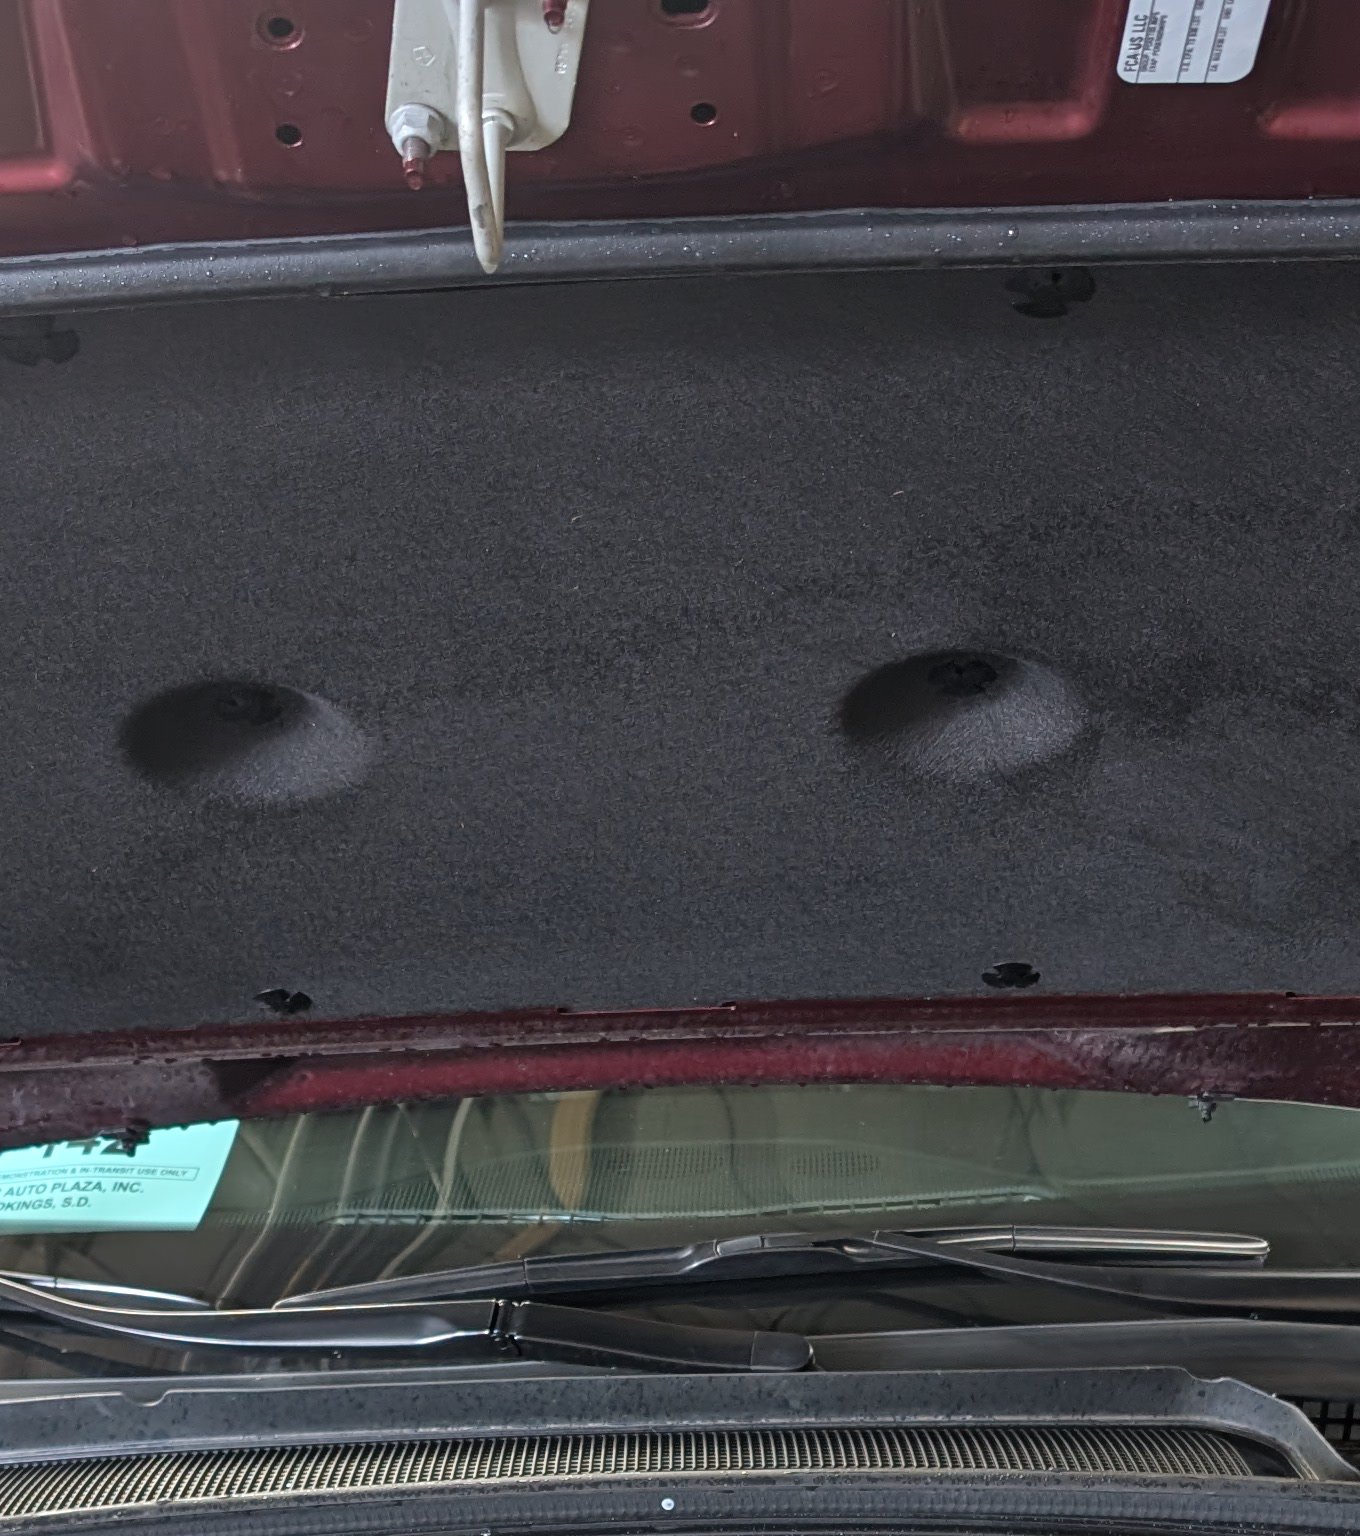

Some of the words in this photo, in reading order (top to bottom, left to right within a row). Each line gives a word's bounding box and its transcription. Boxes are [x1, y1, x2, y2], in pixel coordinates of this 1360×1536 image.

[1131, 14, 1148, 33] LLC
[1128, 36, 1144, 51] US
[1123, 53, 1140, 72] FCA
[80, 1166, 135, 1175] IN-TRANSIT
[160, 1169, 188, 1177] ONLY
[4, 1183, 47, 1198] AUTO
[50, 1181, 107, 1193] PLAZA,
[111, 1181, 144, 1193] INC.
[60, 1196, 92, 1208] S.D.
